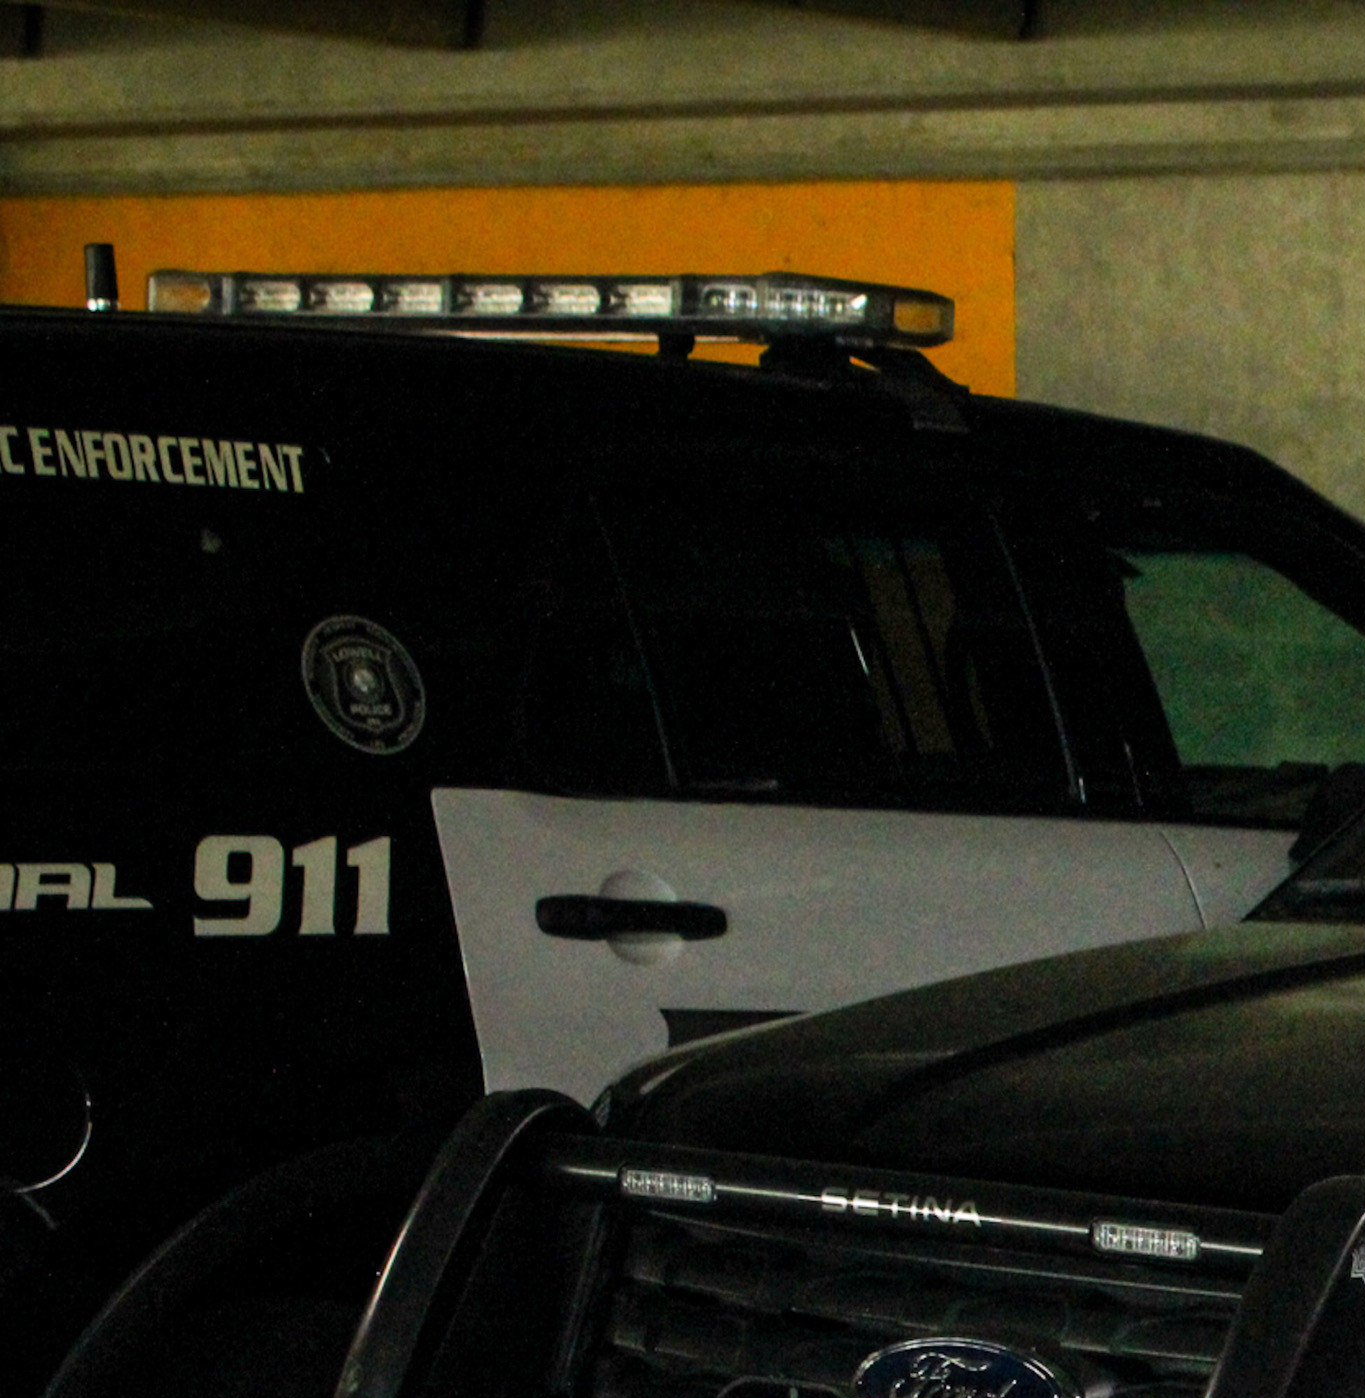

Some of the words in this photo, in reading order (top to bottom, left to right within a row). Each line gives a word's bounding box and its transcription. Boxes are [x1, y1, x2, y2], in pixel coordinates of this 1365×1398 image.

[27, 426, 305, 495] ENFORCEMENT
[192, 834, 391, 937] 911
[821, 1186, 982, 1228] SETINA
